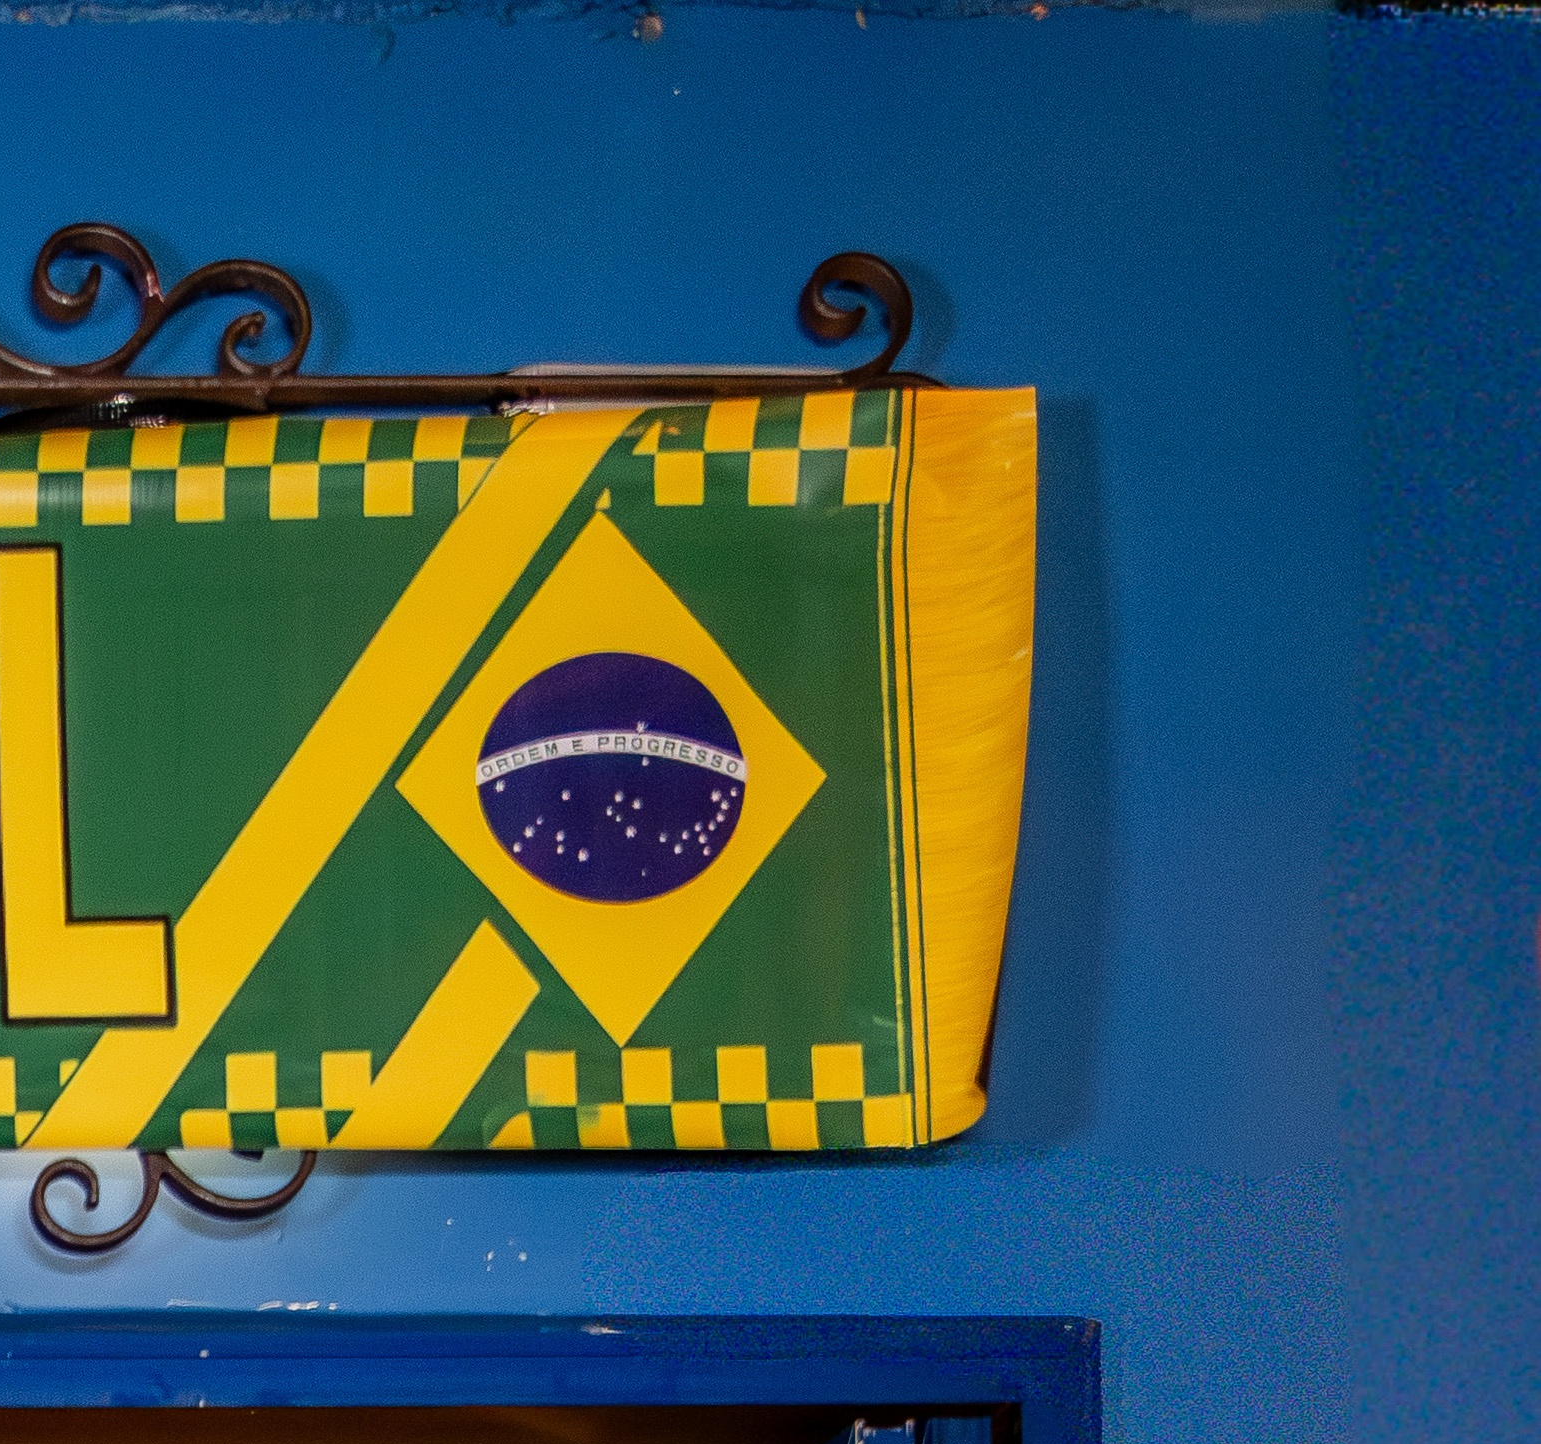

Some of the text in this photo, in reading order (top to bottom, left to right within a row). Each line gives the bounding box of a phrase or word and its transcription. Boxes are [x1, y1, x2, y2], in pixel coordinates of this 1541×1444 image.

[480, 735, 740, 778] ORDEM E PROGRESSO
